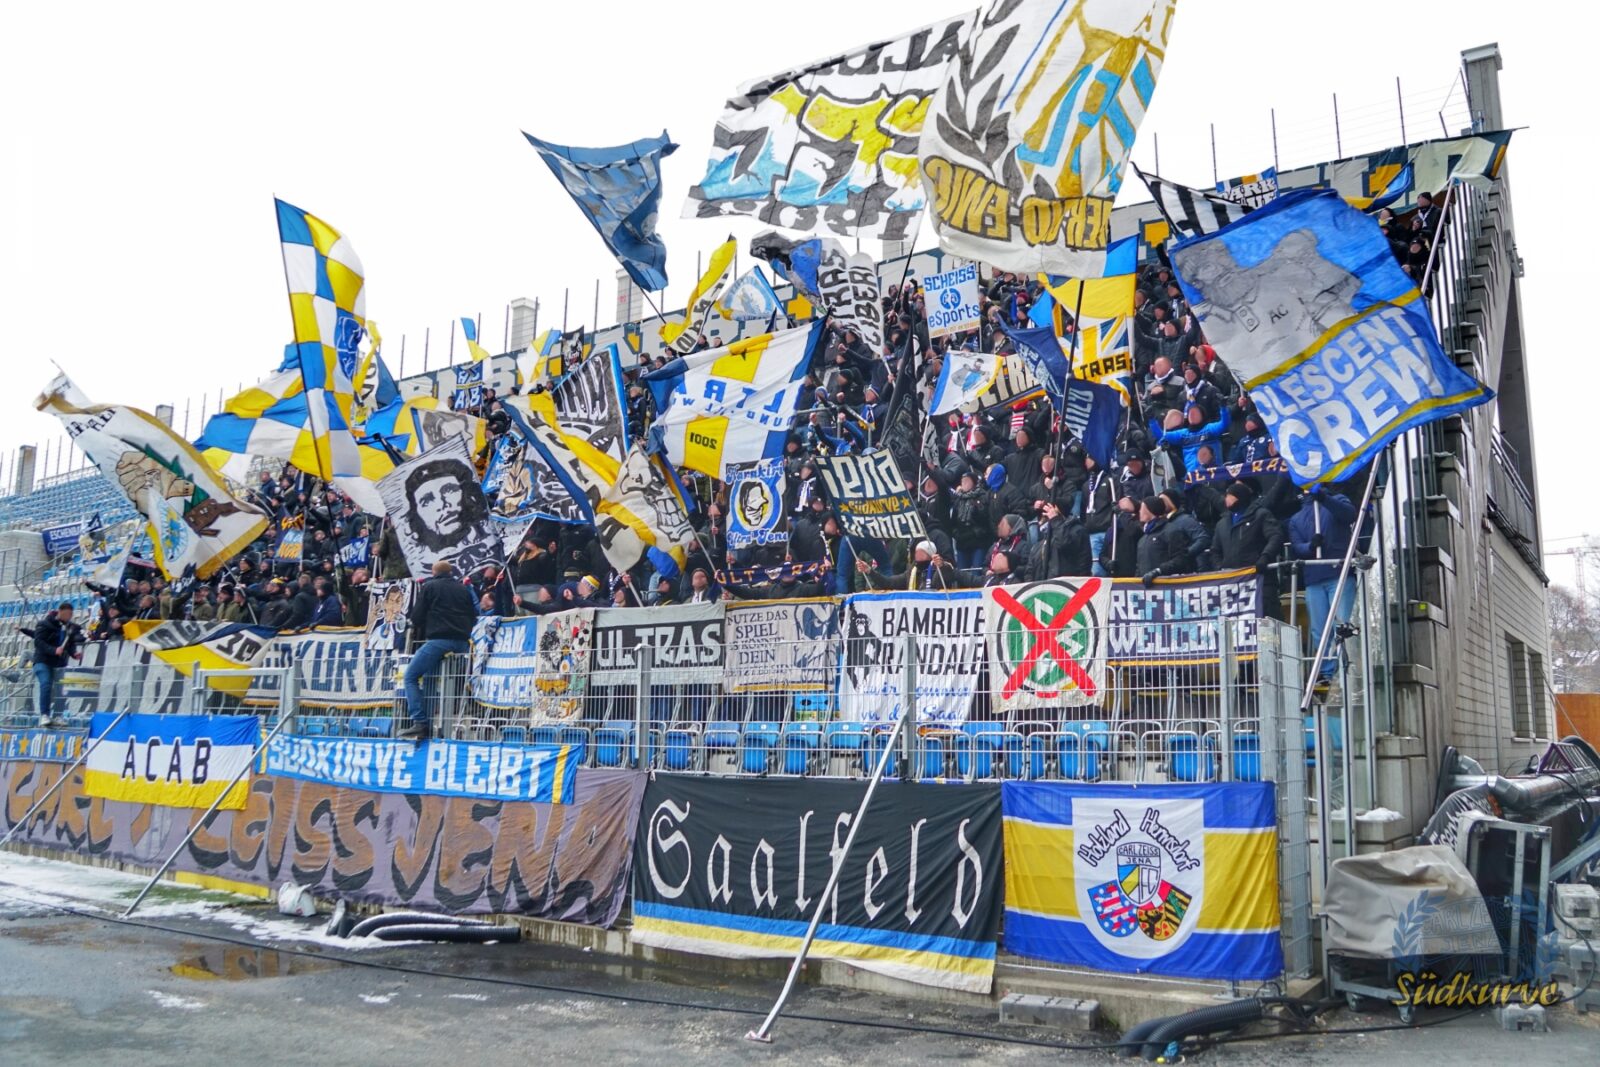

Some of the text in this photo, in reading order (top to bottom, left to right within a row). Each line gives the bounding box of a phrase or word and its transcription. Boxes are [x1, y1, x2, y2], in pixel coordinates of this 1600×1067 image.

[924, 264, 976, 292] SCHEISS
[928, 304, 981, 328] eSports
[1278, 338, 1444, 479] CREW
[1109, 579, 1257, 621] REFUGEES
[727, 610, 788, 626] NUTZE DAS
[736, 622, 778, 639] SPIEL
[597, 622, 722, 668] ULTRAS
[739, 649, 776, 665] DEIN
[121, 735, 213, 785] ACAB
[267, 734, 550, 798] SÜDKURVE BLEIBT
